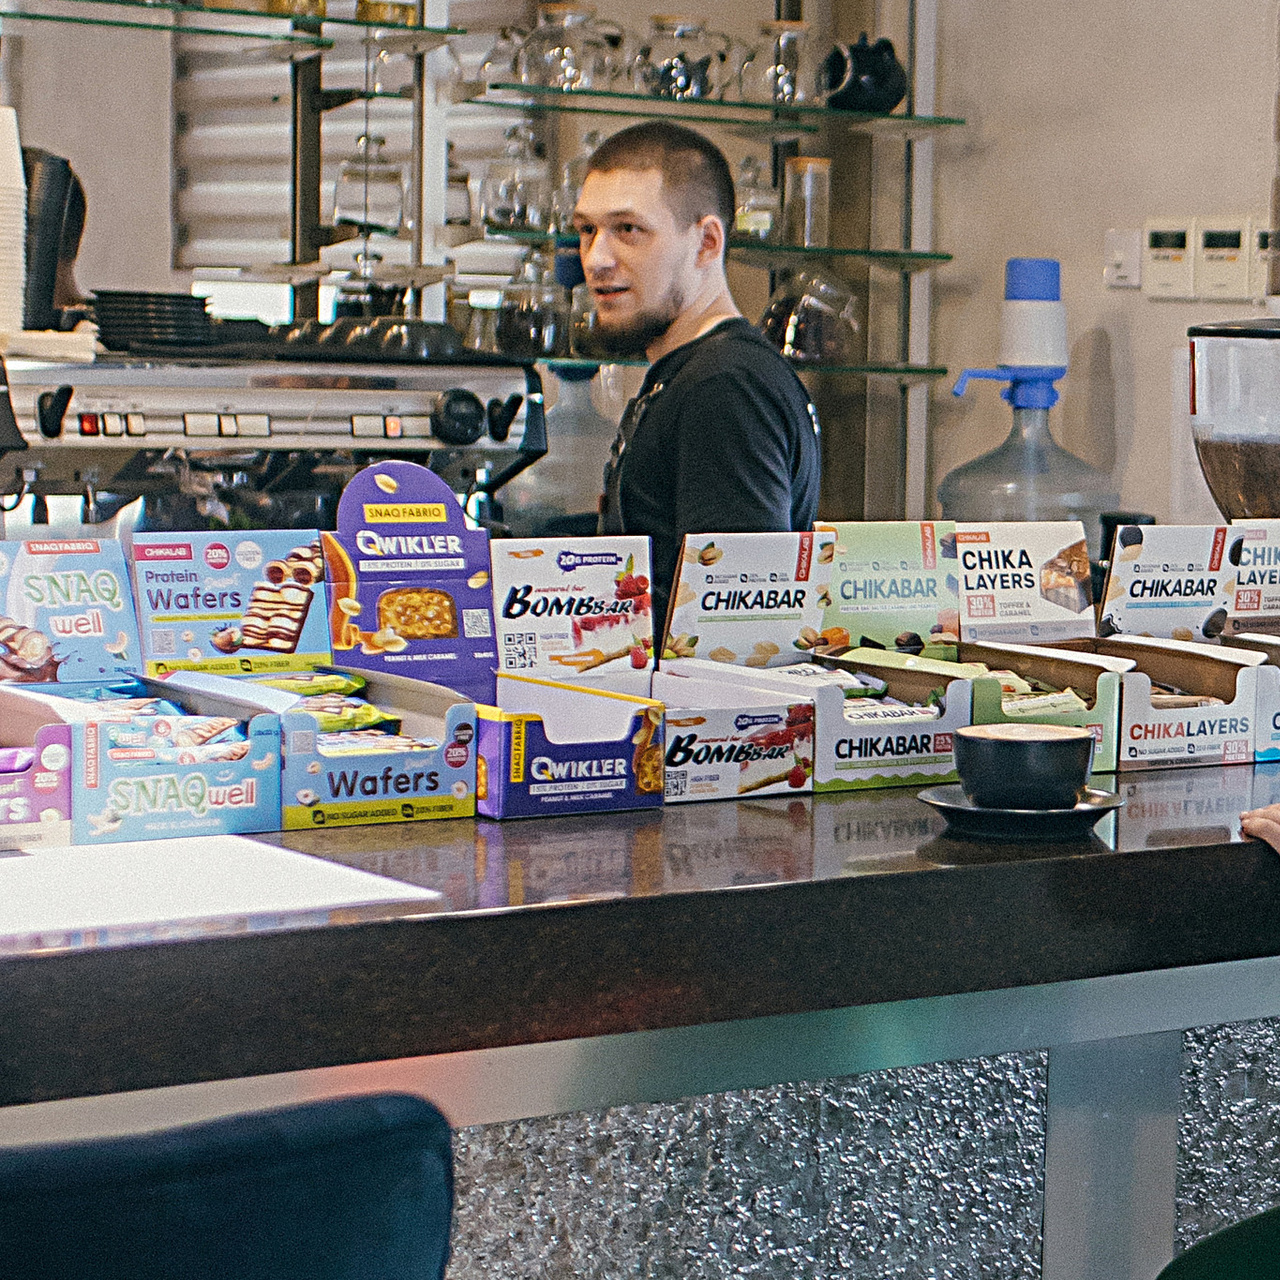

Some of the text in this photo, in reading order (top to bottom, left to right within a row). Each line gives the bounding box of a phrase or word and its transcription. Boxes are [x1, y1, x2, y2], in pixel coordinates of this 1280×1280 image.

[356, 530, 463, 556] QWIKLER
[962, 549, 1033, 570] CHIKA
[145, 570, 199, 583] Protein
[963, 573, 1035, 590] LAYERS
[23, 571, 122, 609] SNAQ
[146, 587, 242, 611] Wafers
[841, 578, 937, 600] CHIKABAR
[1129, 579, 1217, 598] CHIKABAR
[1238, 591, 1258, 603] 30%
[503, 585, 632, 619] BOMBBAR
[701, 589, 806, 611] CHIKABAR
[969, 596, 993, 609] 30%
[53, 611, 102, 634] well
[848, 709, 918, 719] CHIKABAR
[665, 734, 790, 767] BOMBBAR
[834, 733, 931, 759] CHIKABAR
[1226, 741, 1246, 754] 30%
[530, 756, 627, 781] QWIKLER
[327, 766, 440, 798] Wafers
[111, 774, 255, 814] SNAQ well
